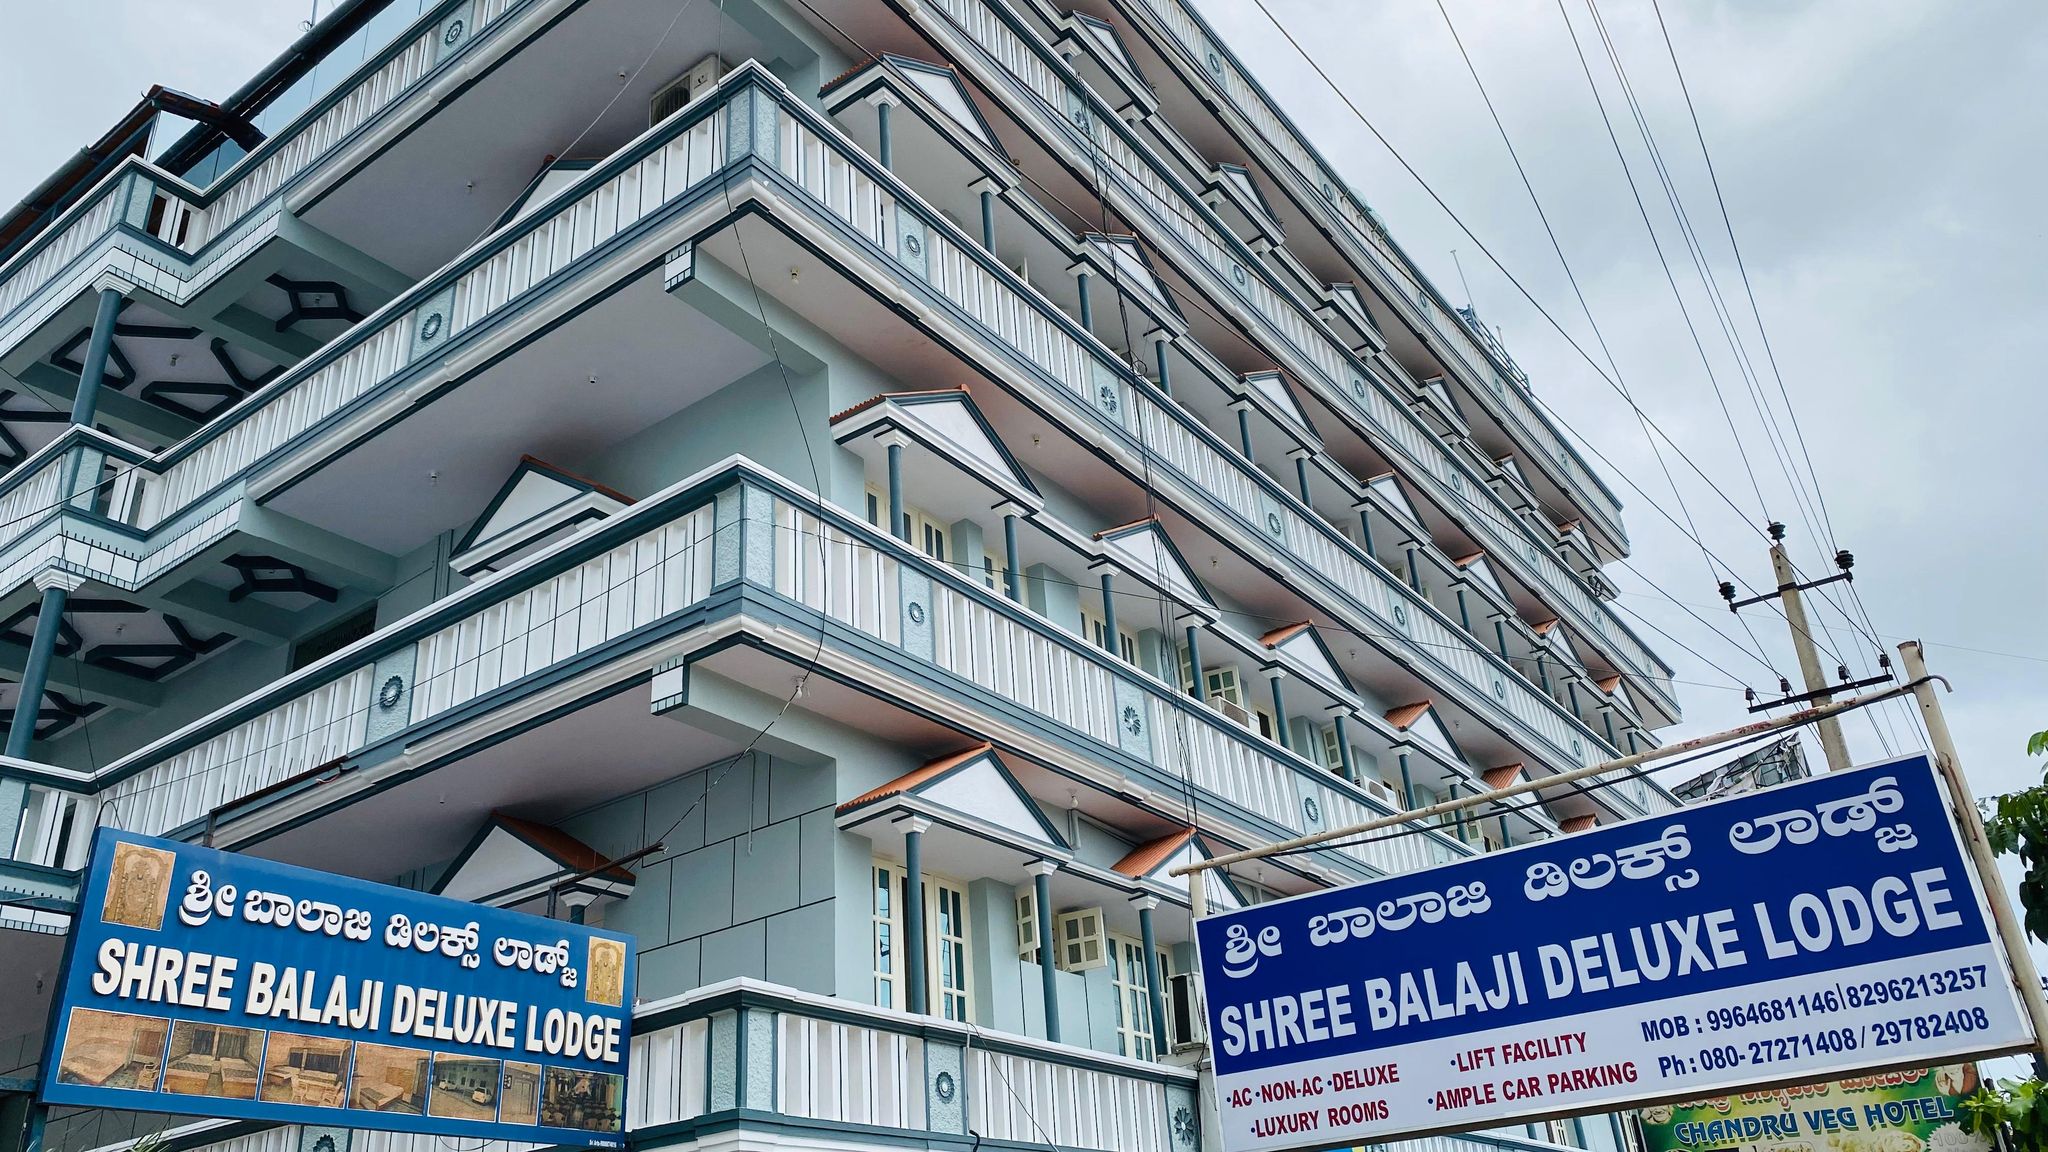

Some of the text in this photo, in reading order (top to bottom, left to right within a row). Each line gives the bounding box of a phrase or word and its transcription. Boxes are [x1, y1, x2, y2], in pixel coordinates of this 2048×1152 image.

[1222, 776, 1919, 979] ಶ್ರೀ ಬಾಲಾಜಿ ಡಿಲಕ್ಸ್ ಲಾಡ್ಜ್
[179, 870, 578, 988] ಶ್ರೀ ಬಾಲಾಜಿ ಡಿಲಕ್ಸ್ ಲಾಡ್ಜ್
[1220, 867, 1963, 1057] SHREE BALAJI DELUXE LODGE
[92, 938, 622, 1063] SHREE BALAJI DELUXE LODGE
[1457, 1032, 1588, 1073] LIFT FACILITY
[1641, 1016, 1690, 1042] MOB
[1658, 1054, 1687, 1078] Ph
[1872, 1006, 1990, 1047] 29782408
[1231, 1063, 1400, 1109] AC NON-AC DELUXE
[1435, 1061, 1638, 1111] AMPLE CAR PARKING
[1255, 1099, 1389, 1138] LUXURY ROOMS
[1674, 1096, 1954, 1144] CHANDRU VEG HOTEL
